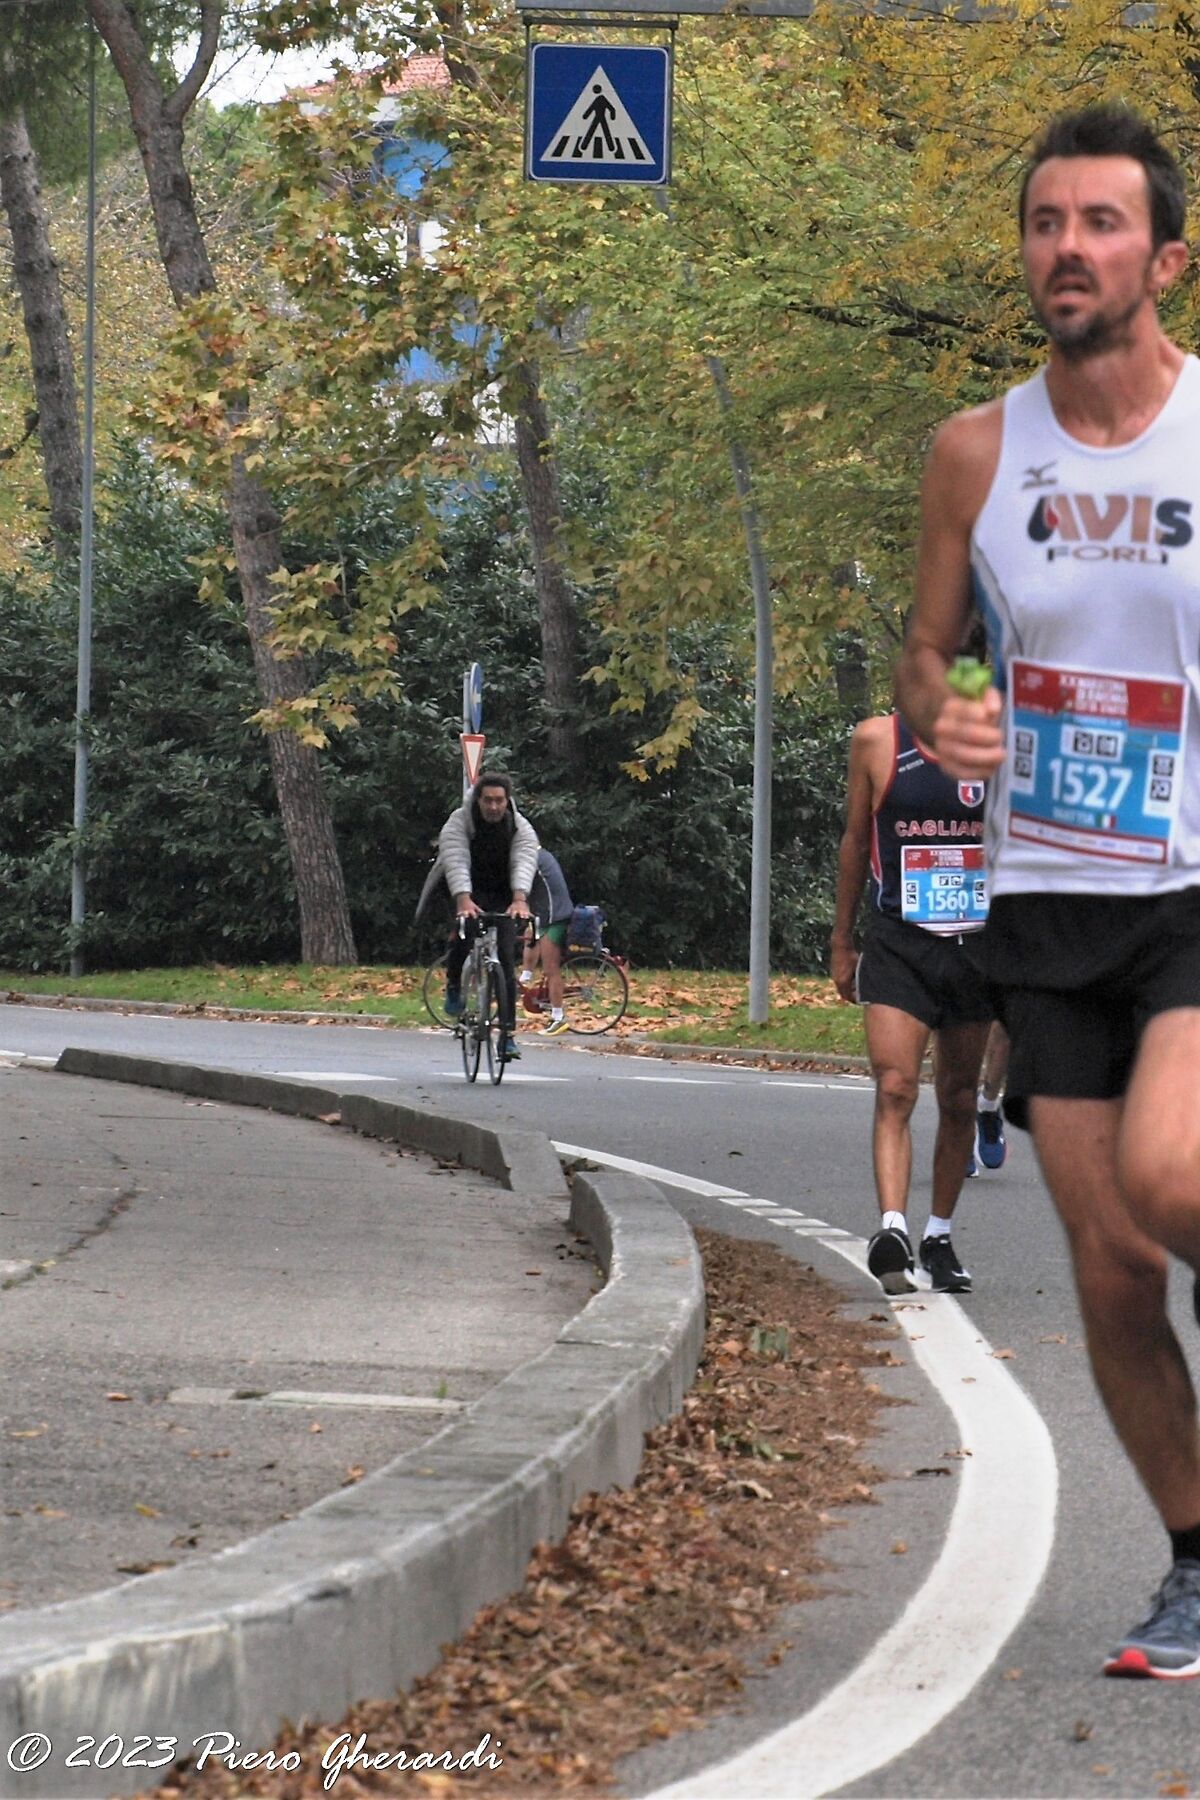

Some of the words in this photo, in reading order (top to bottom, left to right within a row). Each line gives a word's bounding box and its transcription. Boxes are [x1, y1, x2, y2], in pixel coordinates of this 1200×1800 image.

[1027, 494, 1194, 548] AVIS
[1048, 757, 1133, 811] 1527
[925, 890, 969, 912] 1560
